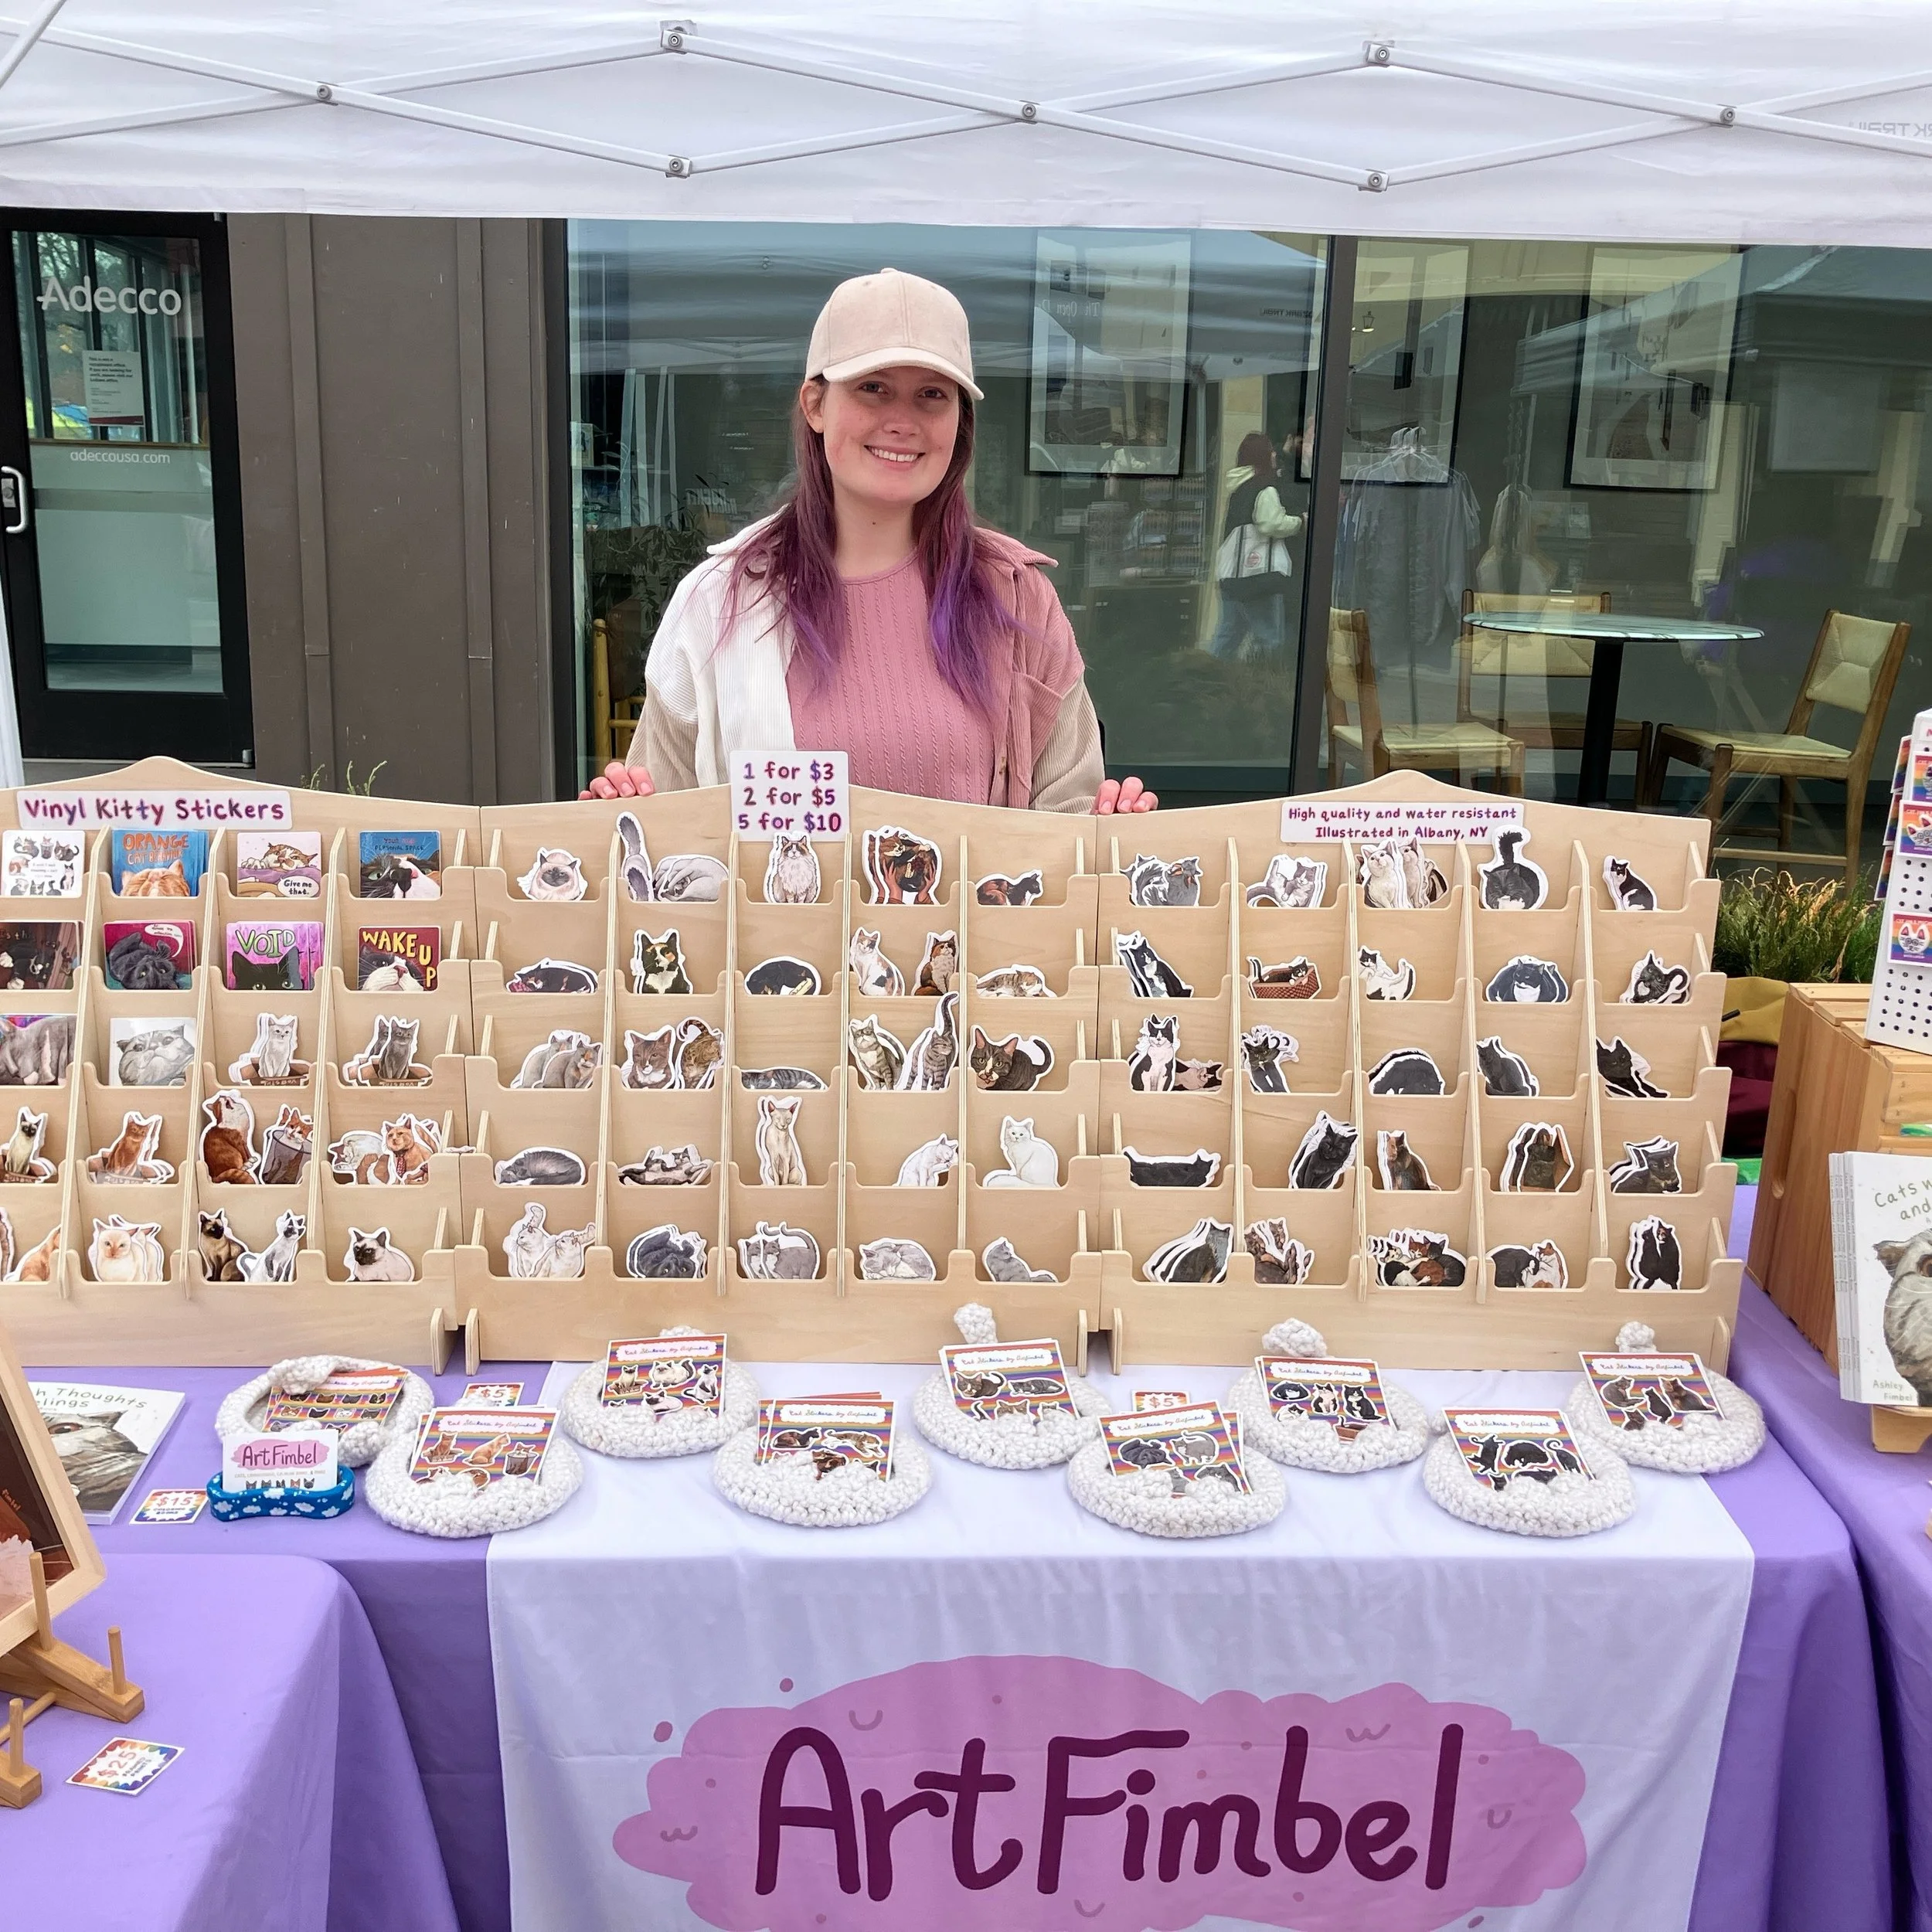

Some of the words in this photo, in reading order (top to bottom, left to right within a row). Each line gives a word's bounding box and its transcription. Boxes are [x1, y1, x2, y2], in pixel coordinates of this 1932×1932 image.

[36, 275, 182, 315] Adecco
[70, 449, 171, 464] adeccousa.com
[743, 762, 755, 780] 1
[764, 760, 800, 780] for
[810, 759, 834, 784] $3
[743, 786, 757, 806] 2
[766, 787, 802, 806] for
[811, 786, 836, 808] $5
[25, 798, 87, 826] Vinyl
[95, 798, 165, 826] Kitty
[175, 798, 284, 820] Stickers
[738, 813, 750, 830] 5
[758, 812, 794, 830] for
[804, 811, 842, 834] $10
[1289, 808, 1315, 821] High
[1321, 808, 1371, 821] quality
[1376, 808, 1400, 818] and
[1406, 808, 1447, 819] water
[1451, 807, 1517, 819] resistant
[124, 832, 189, 851] ORANGE
[1315, 826, 1393, 838] Illustrated
[1398, 827, 1409, 837] in
[1415, 826, 1465, 841] Albany,
[1470, 827, 1488, 838] NY
[128, 852, 147, 865] CAT
[235, 929, 296, 958] VOID
[362, 930, 417, 957] WAKE
[1875, 1182, 1917, 1207] Cats
[1900, 1197, 1931, 1220] and
[481, 1388, 506, 1398] $5
[1872, 1379, 1903, 1391] Ashley
[56, 1388, 147, 1409] Thoughts
[1149, 1396, 1174, 1409] $5
[1884, 1393, 1913, 1401] Fimbel
[243, 1443, 317, 1467] ArtFimbel
[156, 1496, 193, 1507] $15
[98, 1750, 136, 1777] $25
[754, 1723, 1464, 1902] ArtFimbel
